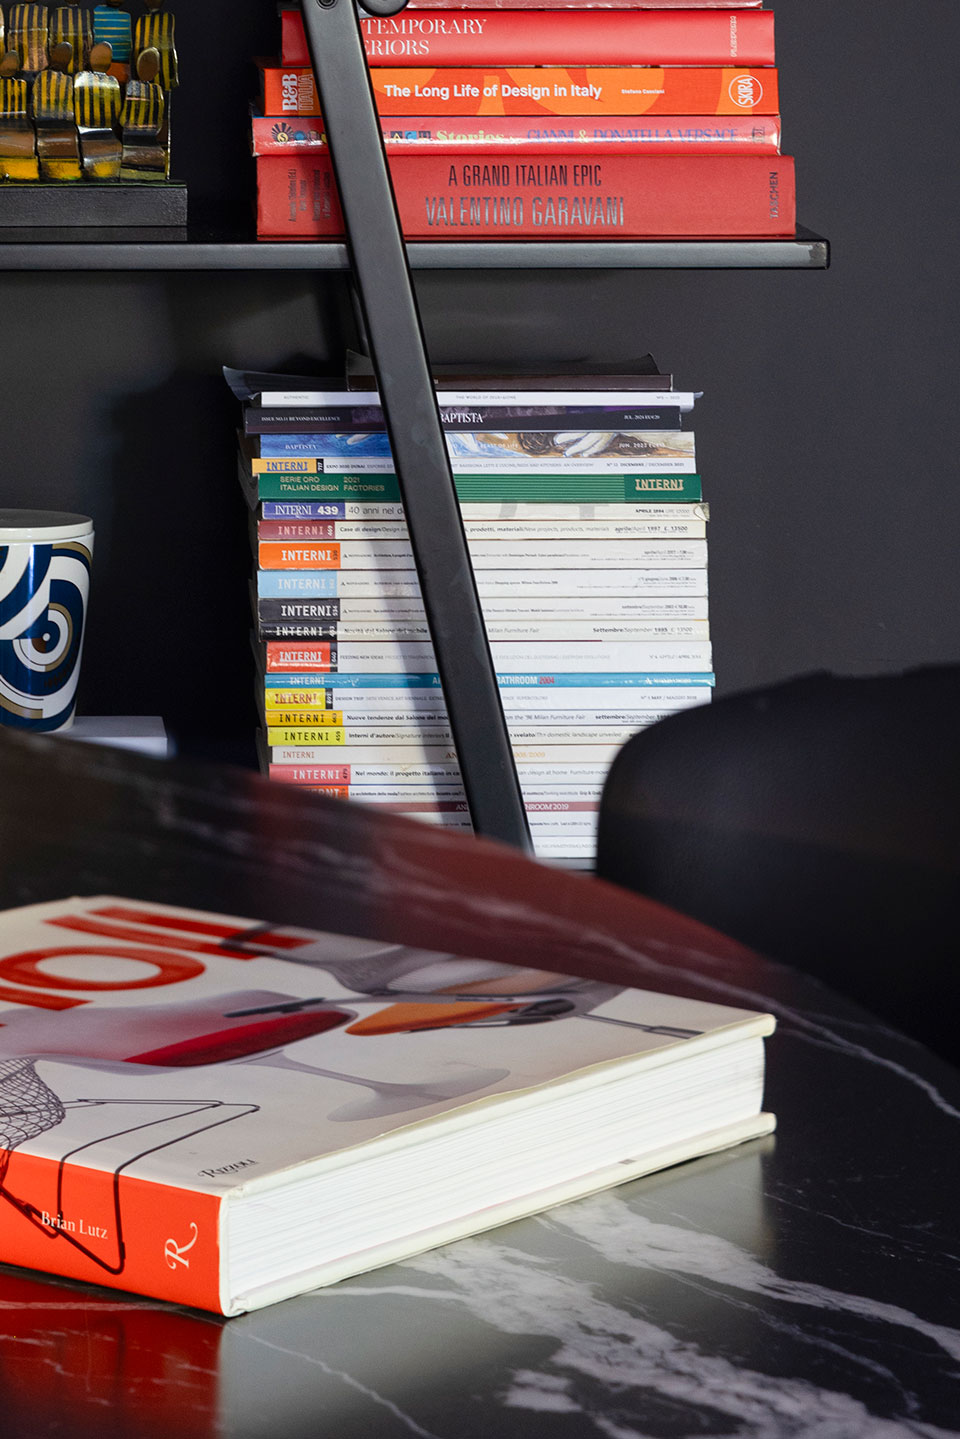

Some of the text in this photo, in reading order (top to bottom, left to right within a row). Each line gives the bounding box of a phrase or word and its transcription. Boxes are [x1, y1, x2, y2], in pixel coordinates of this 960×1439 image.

[359, 18, 487, 35] TEMPORARY
[282, 73, 298, 111] B&B
[384, 84, 411, 97] The
[414, 84, 450, 100] Long
[453, 84, 480, 97] Life
[482, 84, 499, 97] of
[501, 84, 550, 100] Design
[553, 84, 568, 97] in
[570, 84, 603, 100] Italy
[737, 77, 755, 105] SKIRA
[448, 164, 602, 187] A GRAND ITALIAN EPIC
[770, 171, 779, 219] TASCHEN
[425, 196, 625, 227] VALENTINO GARAVANI
[266, 461, 309, 472] INTERNI
[279, 484, 310, 492] ITALIAN
[310, 484, 339, 492] DESIGN
[635, 478, 685, 491] INTERNI
[274, 505, 313, 516] INTERNI
[317, 505, 339, 515] 439
[278, 525, 324, 536] INTERNI
[281, 549, 333, 561] INTERNI
[278, 578, 327, 590] INTERNI
[280, 605, 332, 617] INTERNI
[275, 626, 323, 637] INTERNI
[279, 651, 322, 663] INTERNI
[289, 676, 325, 686] INTERNI
[274, 693, 318, 705] INTERNI
[279, 713, 325, 723] INTERNI
[284, 731, 330, 741] INTERNI
[282, 751, 316, 759] INTERNI
[293, 769, 340, 780] INTERNI
[40, 1210, 109, 1240] Brian Lutz
[163, 1221, 199, 1271] R
